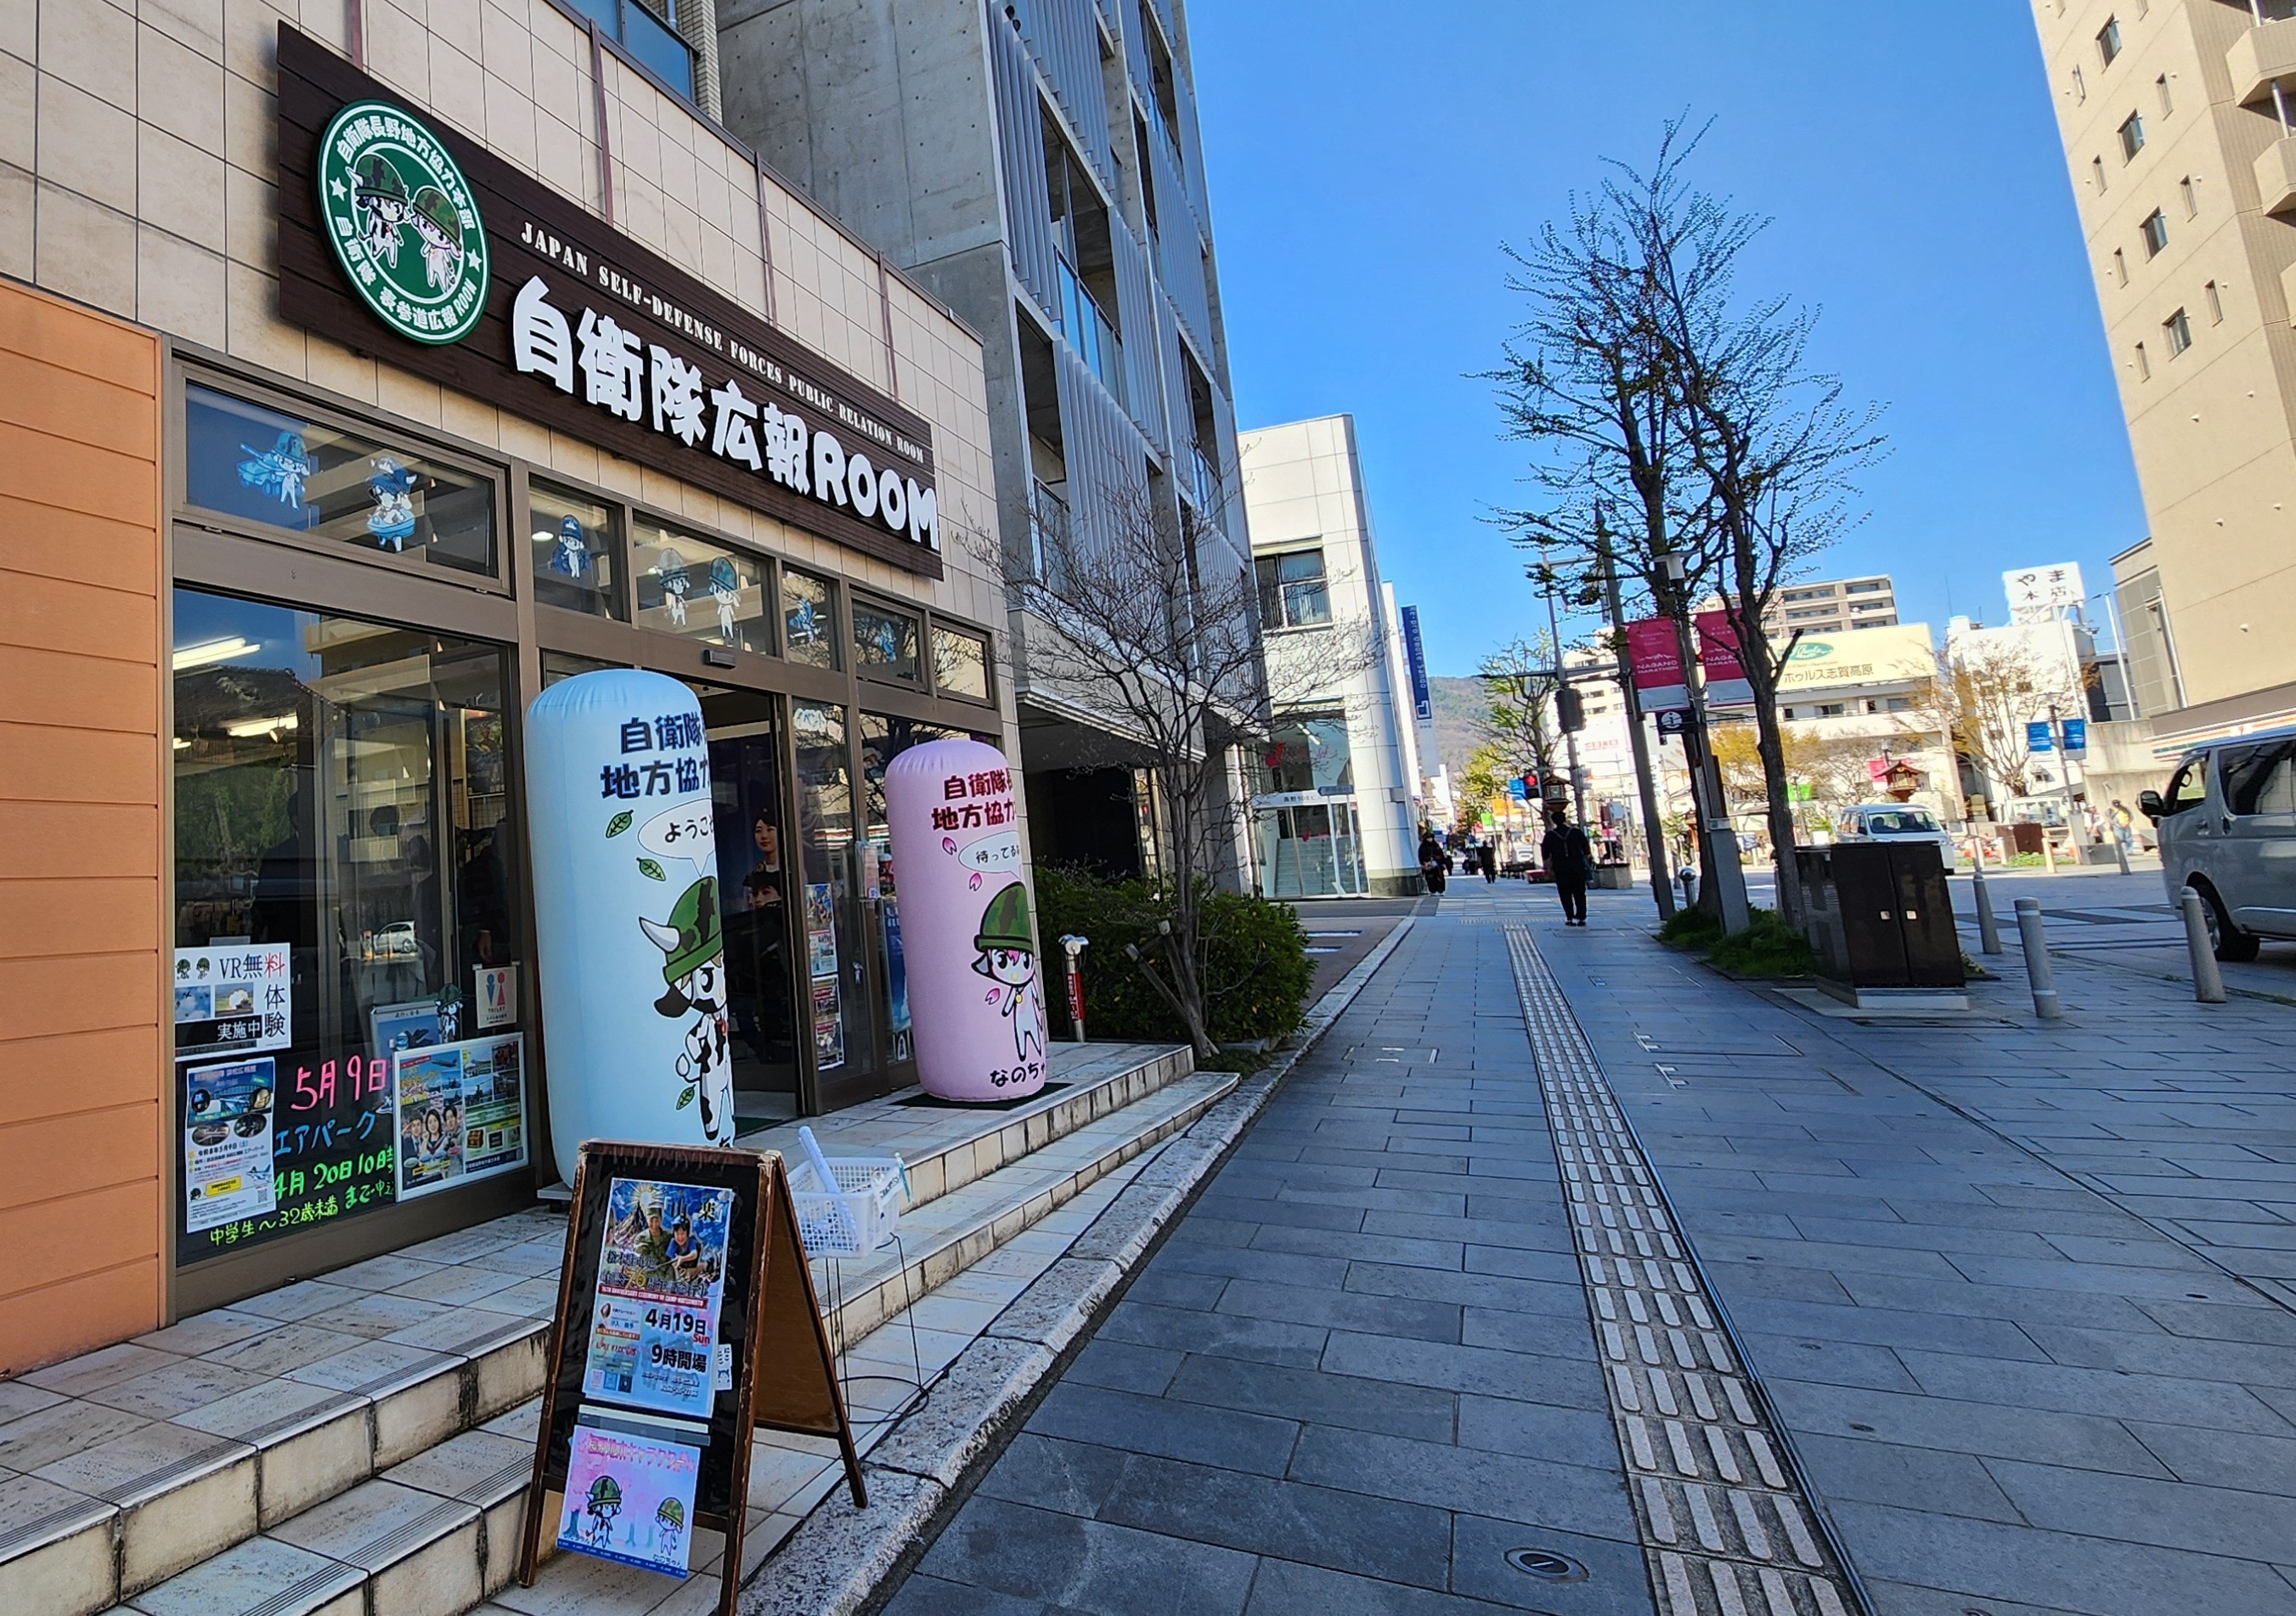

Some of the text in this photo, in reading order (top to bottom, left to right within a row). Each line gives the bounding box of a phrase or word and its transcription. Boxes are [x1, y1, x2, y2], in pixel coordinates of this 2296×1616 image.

[336, 116, 475, 230] 自衛隊長野地方協力本部
[336, 216, 376, 286] 自衛隊
[521, 222, 924, 464] JAPAN SELF-DEFENSE FORCES PUBLIC RELATION ROOM
[512, 274, 940, 551] 自衛隊広報ROOM
[1637, 660, 1678, 670] NAGANO
[1638, 665, 1679, 675] MARATHON
[621, 712, 707, 754] 自衛隊
[217, 1020, 261, 1042] 実施中
[263, 983, 286, 1038] 体験
[291, 1054, 386, 1110] 5月9日
[274, 1110, 375, 1157] エアパーク
[645, 1308, 707, 1336] 4月19日
[692, 1333, 710, 1346] Sun
